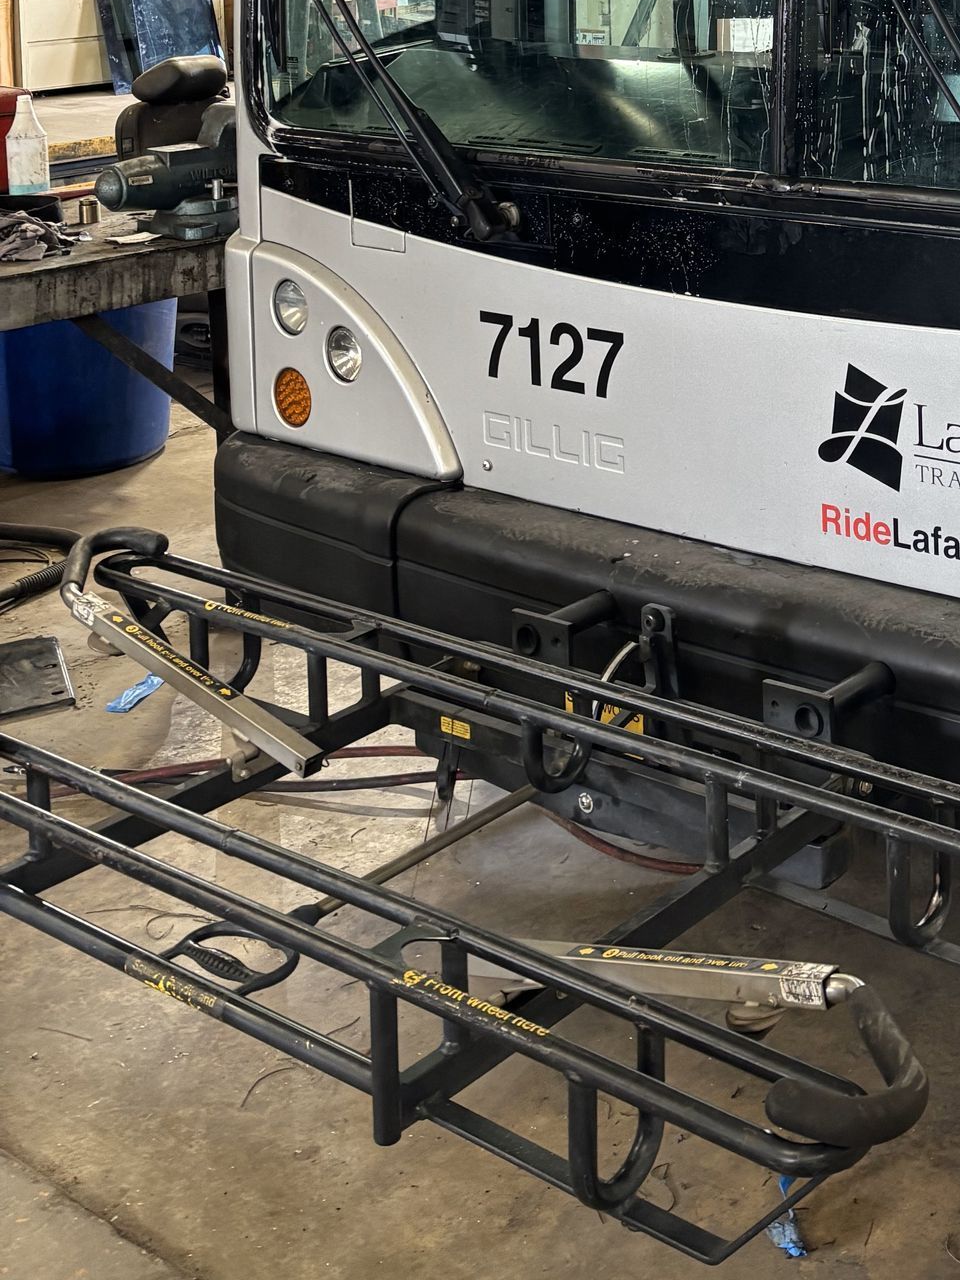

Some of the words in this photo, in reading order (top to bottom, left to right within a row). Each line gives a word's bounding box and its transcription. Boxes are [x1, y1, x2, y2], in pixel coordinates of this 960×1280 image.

[479, 309, 625, 399] 7127
[482, 410, 625, 475] GILLIG
[616, 950, 637, 960] Pull
[637, 951, 662, 962] hook
[664, 953, 683, 964] out
[682, 955, 704, 966] and
[424, 978, 468, 1002] Front
[466, 996, 513, 1021] wheel
[512, 1013, 550, 1037] here
